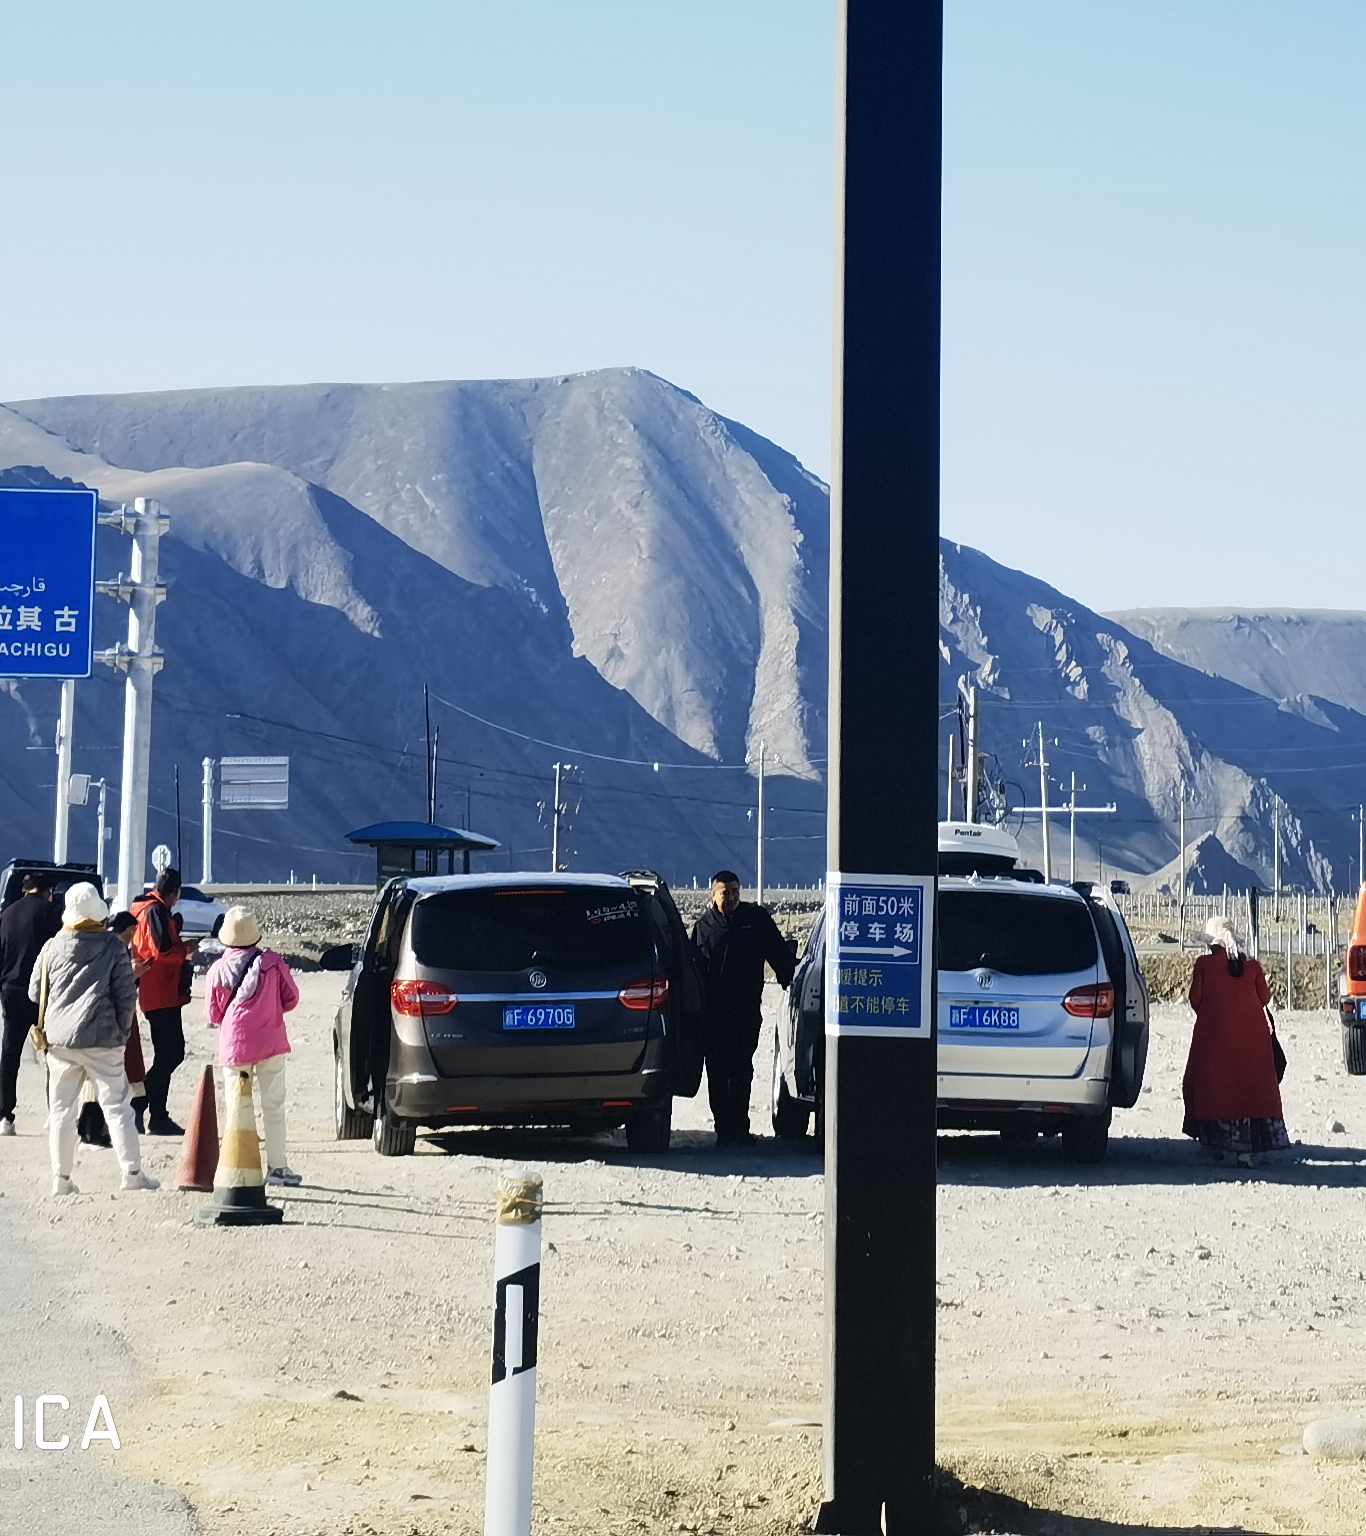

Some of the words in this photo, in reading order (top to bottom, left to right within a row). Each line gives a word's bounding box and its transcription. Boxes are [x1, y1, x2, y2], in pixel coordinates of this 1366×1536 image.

[844, 893, 914, 917] 前面50米
[840, 921, 914, 943] 停车场
